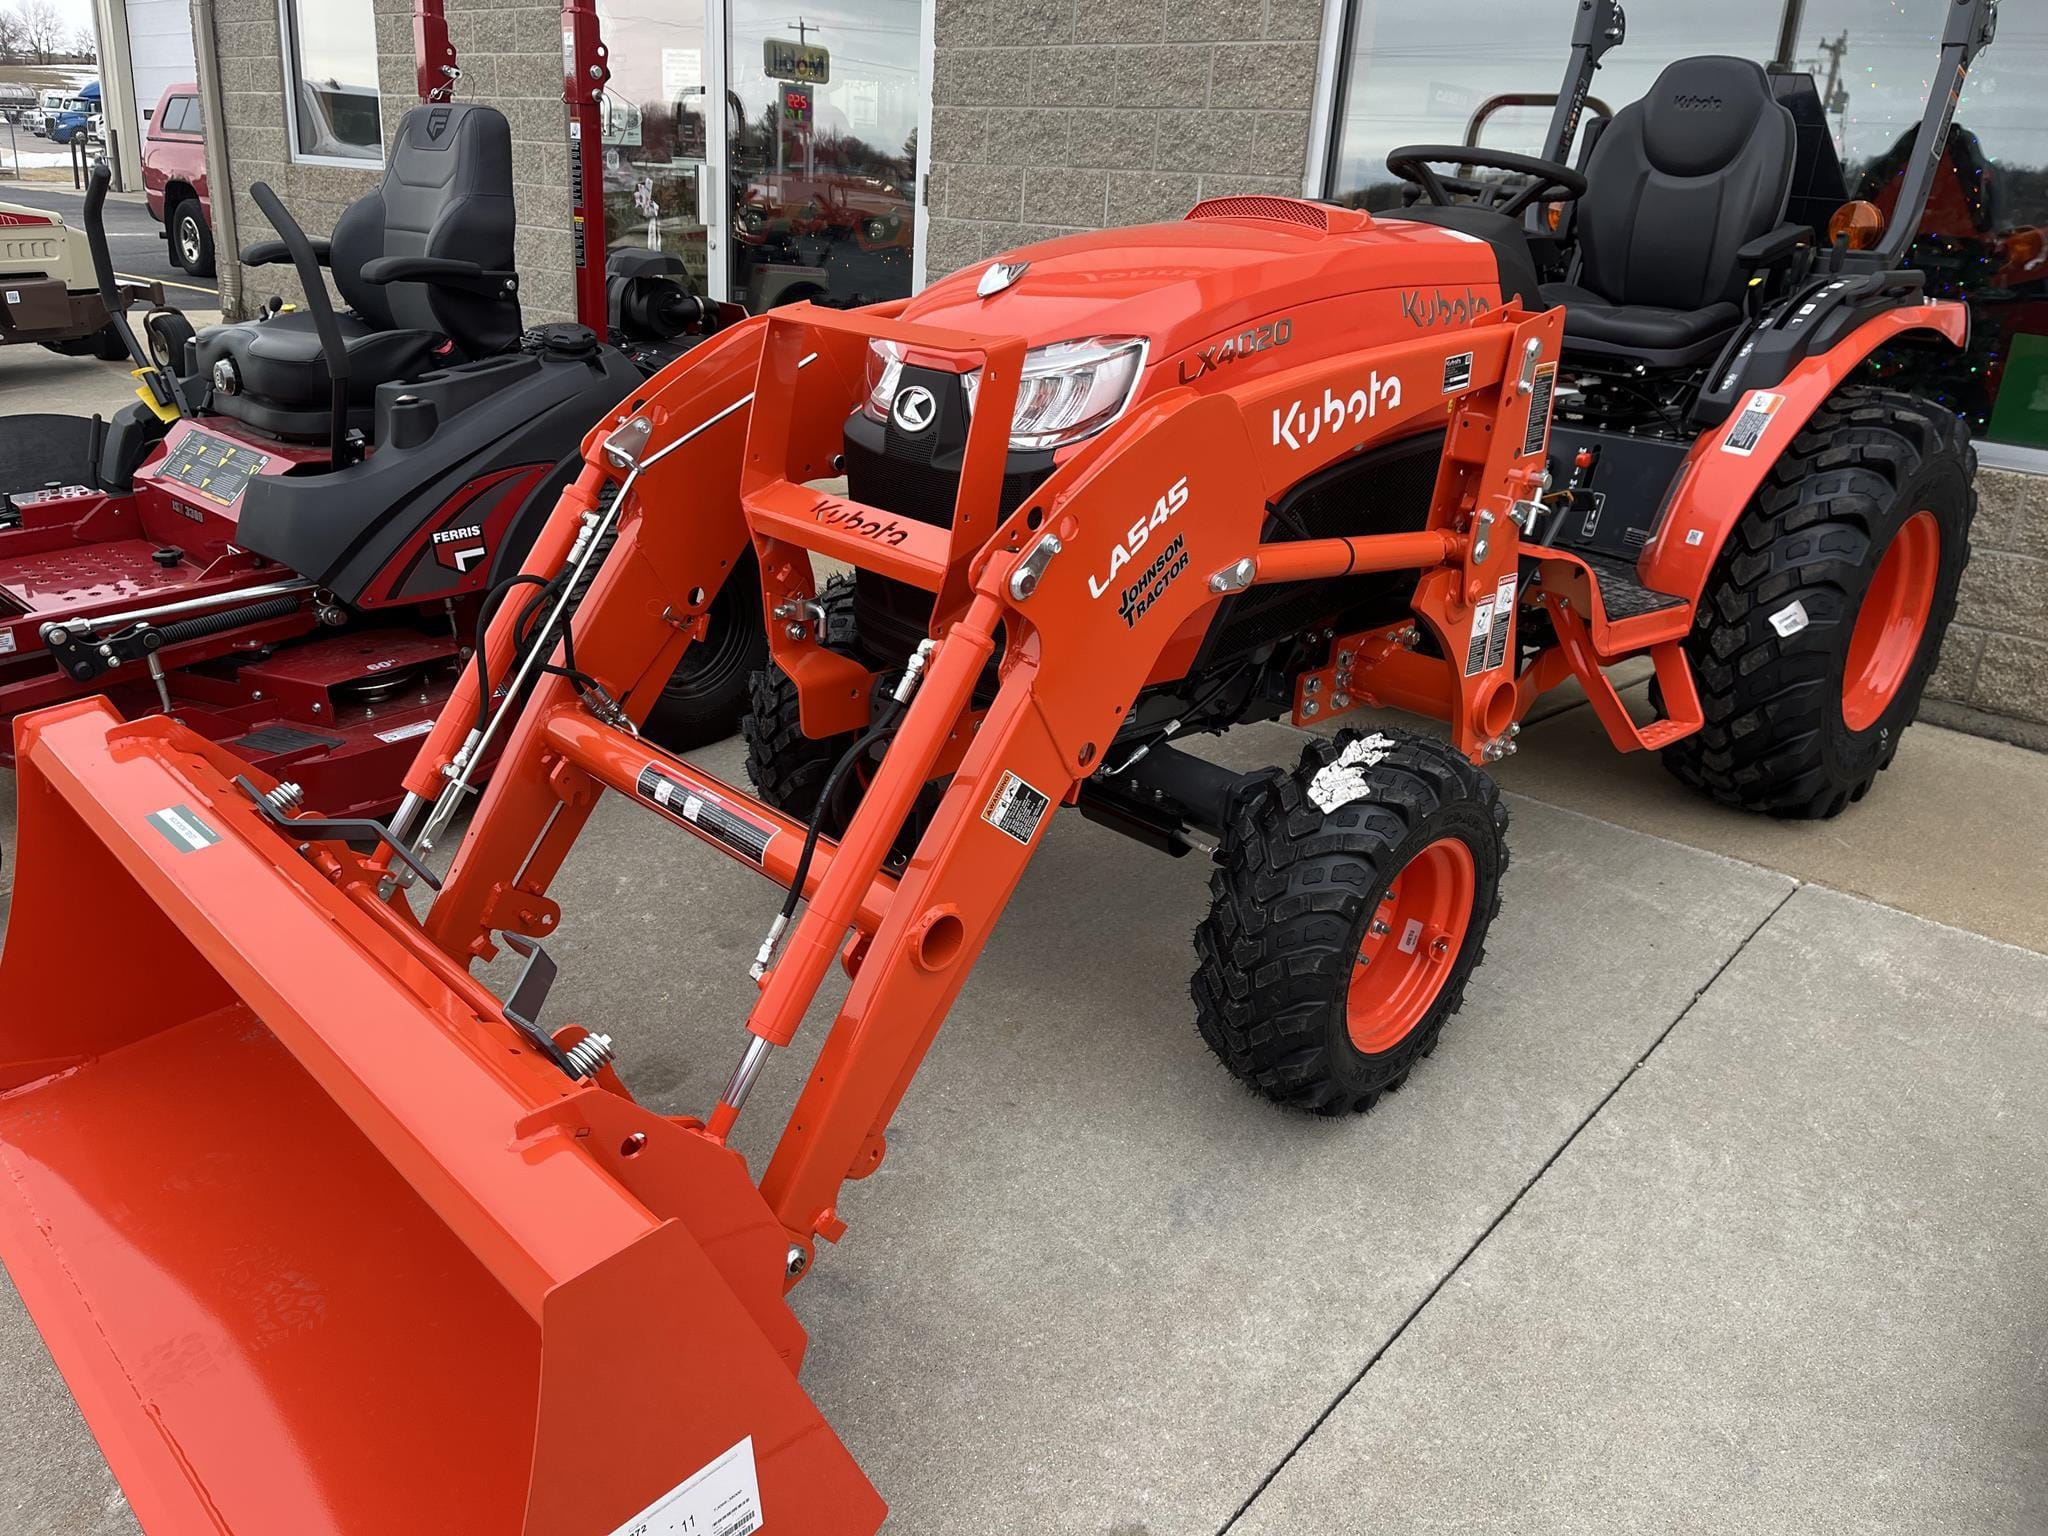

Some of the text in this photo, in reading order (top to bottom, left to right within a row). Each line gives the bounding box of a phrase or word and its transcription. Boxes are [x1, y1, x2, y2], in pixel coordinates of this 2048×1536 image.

[1673, 95, 1722, 111] Kubota
[1179, 317, 1292, 385] LX4020
[1272, 370, 1401, 450] Kubota
[432, 525, 480, 544] FERRIS
[810, 500, 908, 546] Kubota
[1088, 476, 1189, 599] LA545
[1118, 533, 1184, 615] JOHNSON
[1123, 551, 1189, 628] TRACTOR
[989, 775, 1011, 811] WARNING
[681, 1514, 695, 1532] 11
